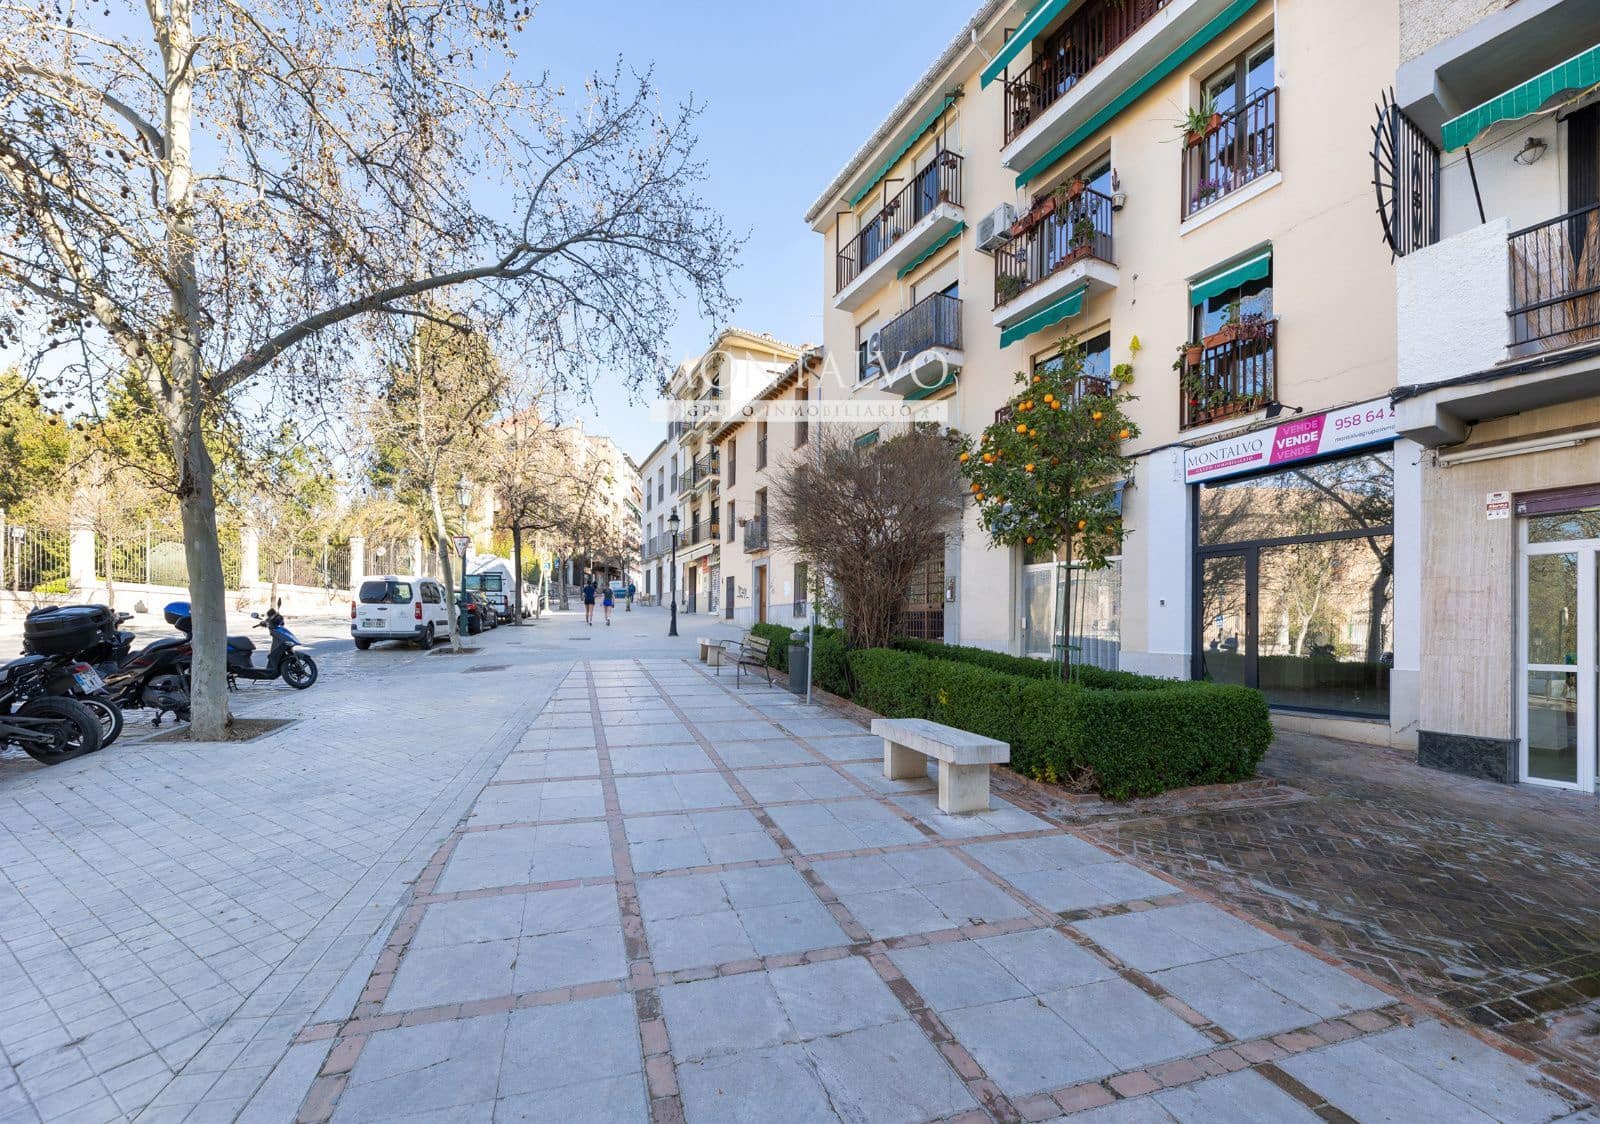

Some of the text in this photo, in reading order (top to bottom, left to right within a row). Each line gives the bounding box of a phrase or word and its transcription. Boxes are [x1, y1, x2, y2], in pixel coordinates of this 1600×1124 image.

[1282, 419, 1319, 436] VENDE
[1335, 414, 1362, 430] 958
[1365, 408, 1385, 423] 64
[1276, 430, 1319, 449] VENDE
[1187, 438, 1264, 468] MONTALVO
[1276, 445, 1312, 460] VENDE
